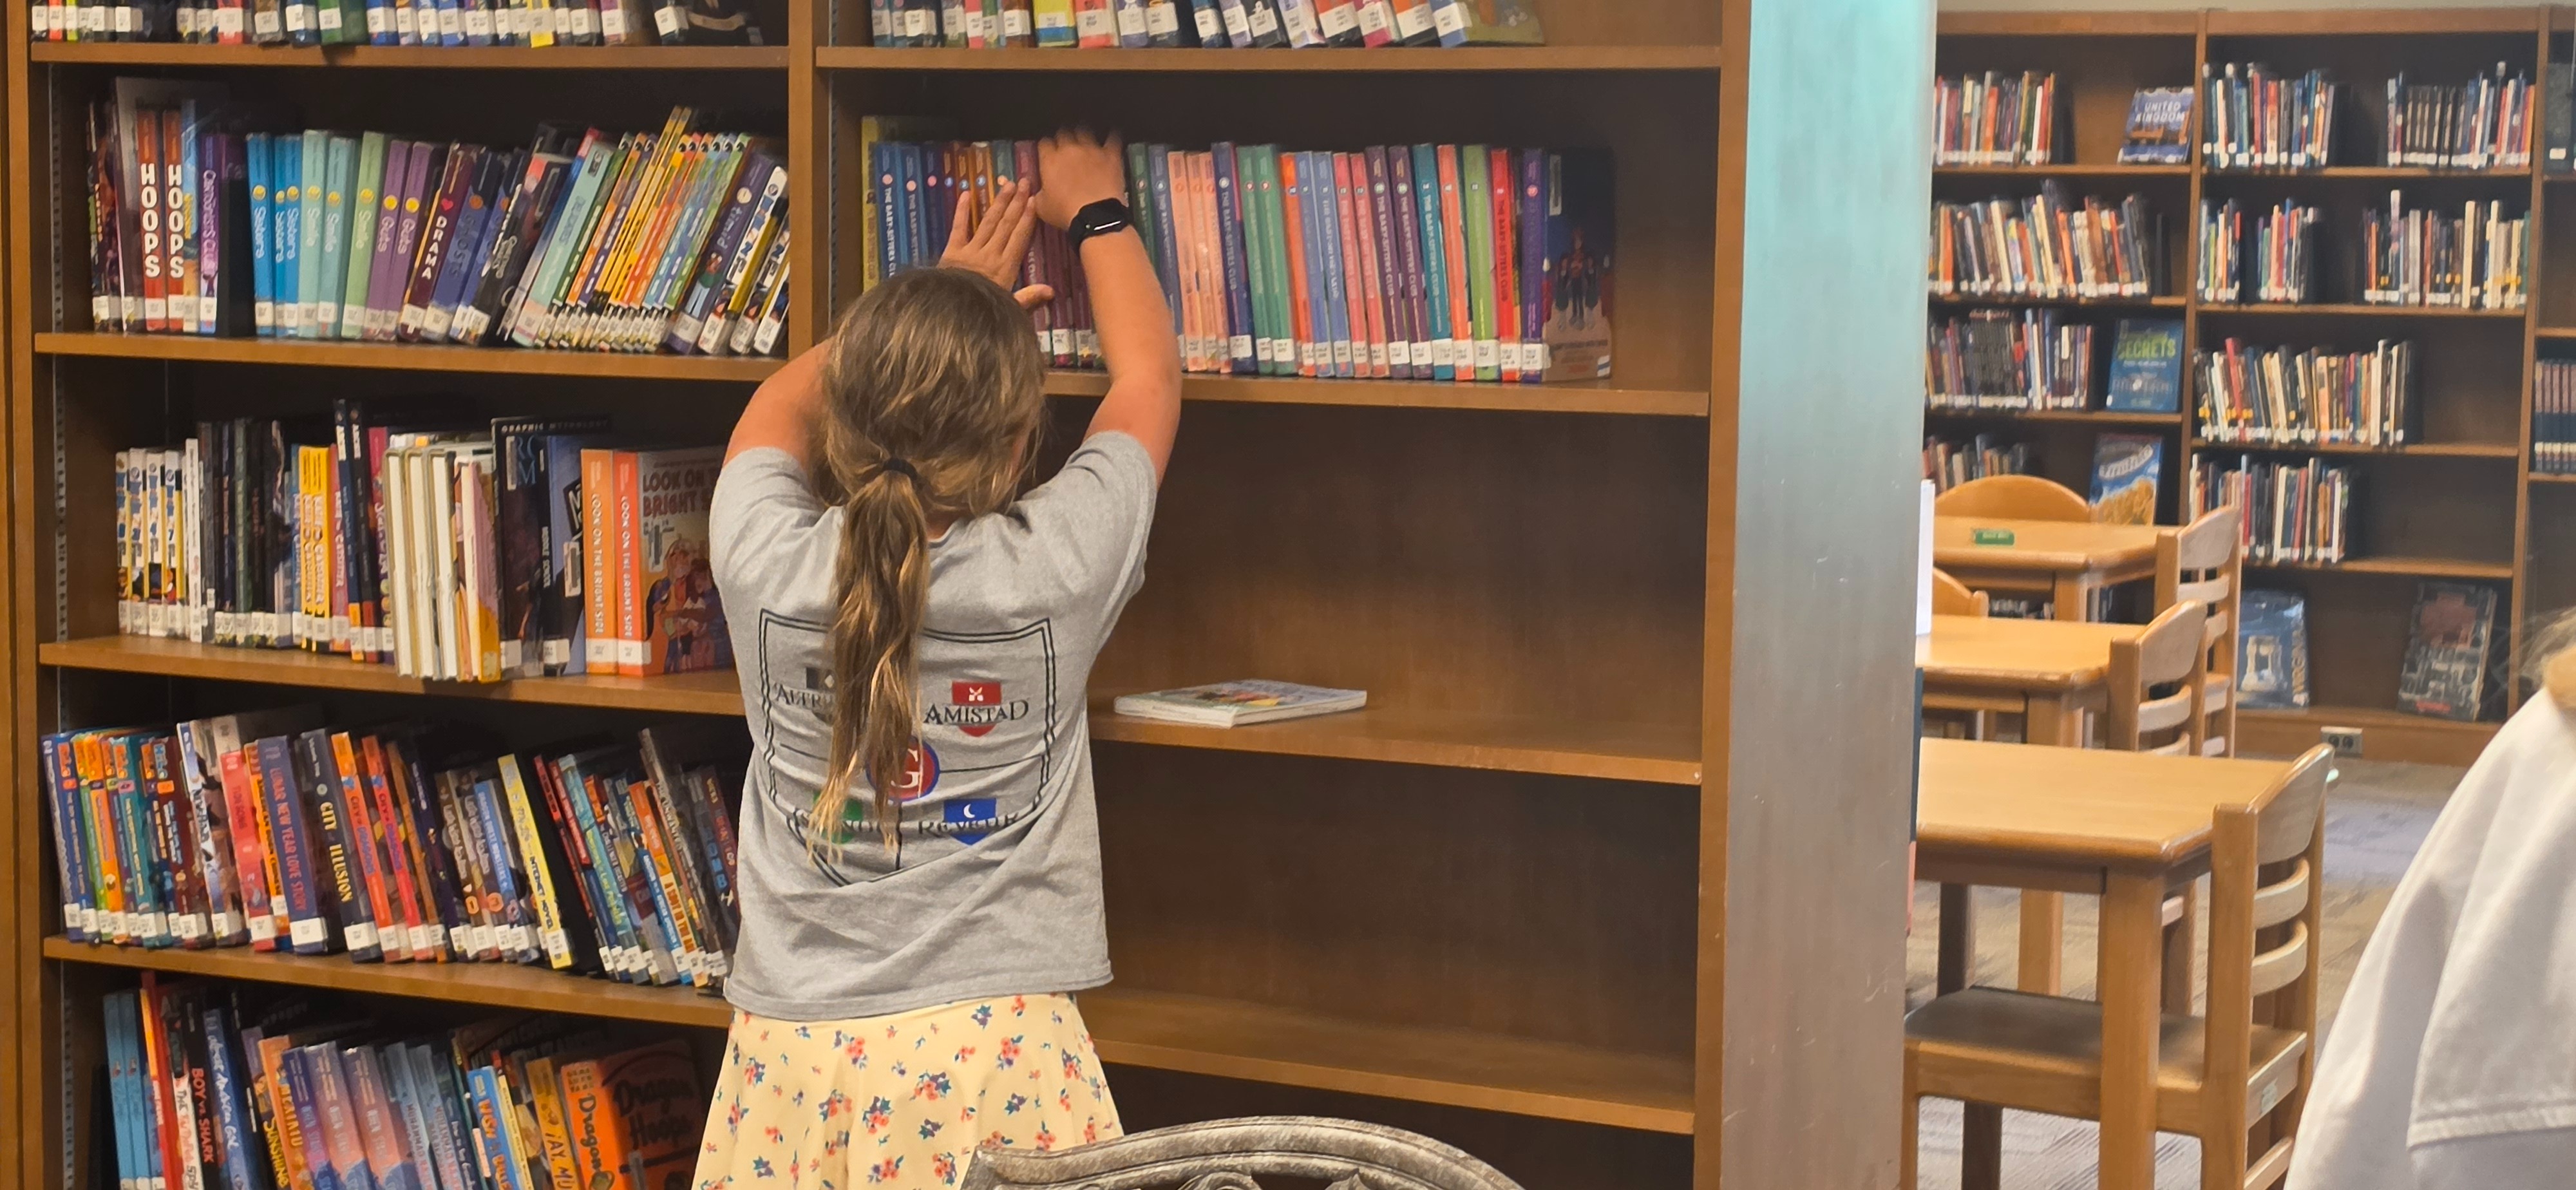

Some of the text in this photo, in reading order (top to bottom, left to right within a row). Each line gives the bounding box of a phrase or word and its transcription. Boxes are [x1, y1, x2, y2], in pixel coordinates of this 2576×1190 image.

[2135, 111, 2186, 123] KINGDOM
[2144, 100, 2182, 112] UNITED
[140, 162, 160, 277] HOOPS
[167, 164, 184, 277] HOOPS
[884, 187, 892, 203] THE
[253, 206, 268, 258] Sisters
[275, 211, 285, 263] Sisters
[286, 207, 298, 259] Sisters
[306, 207, 319, 247] Smile
[324, 211, 339, 253] Smile
[355, 209, 371, 250] Smile
[377, 214, 395, 253] Guts
[397, 216, 417, 256] Guts
[421, 214, 448, 280] DRAMA
[1222, 209, 1236, 266] BABY-SITTERS
[1376, 196, 1395, 296] THE BABY-SITTERS CLUB
[1399, 196, 1417, 296] THE BABY-SITTERS CLUB
[1423, 194, 1439, 296] THE BABY-SITTERS CLUB
[1498, 218, 1507, 277] BABY-SITTERS
[1227, 267, 1238, 290] CLUB
[2117, 337, 2176, 360] SECRETS
[502, 422, 544, 433] GRAPHIC
[643, 468, 705, 493] LOOK ON
[643, 489, 697, 518] BRIGHT
[591, 493, 605, 634] LOOK ON THE BRIGHT SIDE
[620, 496, 632, 636] LOOK ON THE BRIGHT SIDE
[923, 699, 1030, 726] AMISTAD
[891, 748, 921, 789] G
[349, 794, 363, 819] CITY
[269, 766, 308, 911] LUNAR NEW YEAR LOVE STORY
[319, 800, 353, 902] CITY ILLUSION
[527, 855, 554, 930] INTERNET NOVEL
[191, 1066, 207, 1100] BOY
[176, 1090, 189, 1111] THE
[185, 1164, 198, 1189] SPY
[198, 1117, 214, 1164] SHARK
[403, 1103, 427, 1157] MUHAMMAD
[477, 1099, 498, 1139] WISH
[578, 1095, 601, 1172] Dragon
[263, 1115, 289, 1188] SUNSHINE
